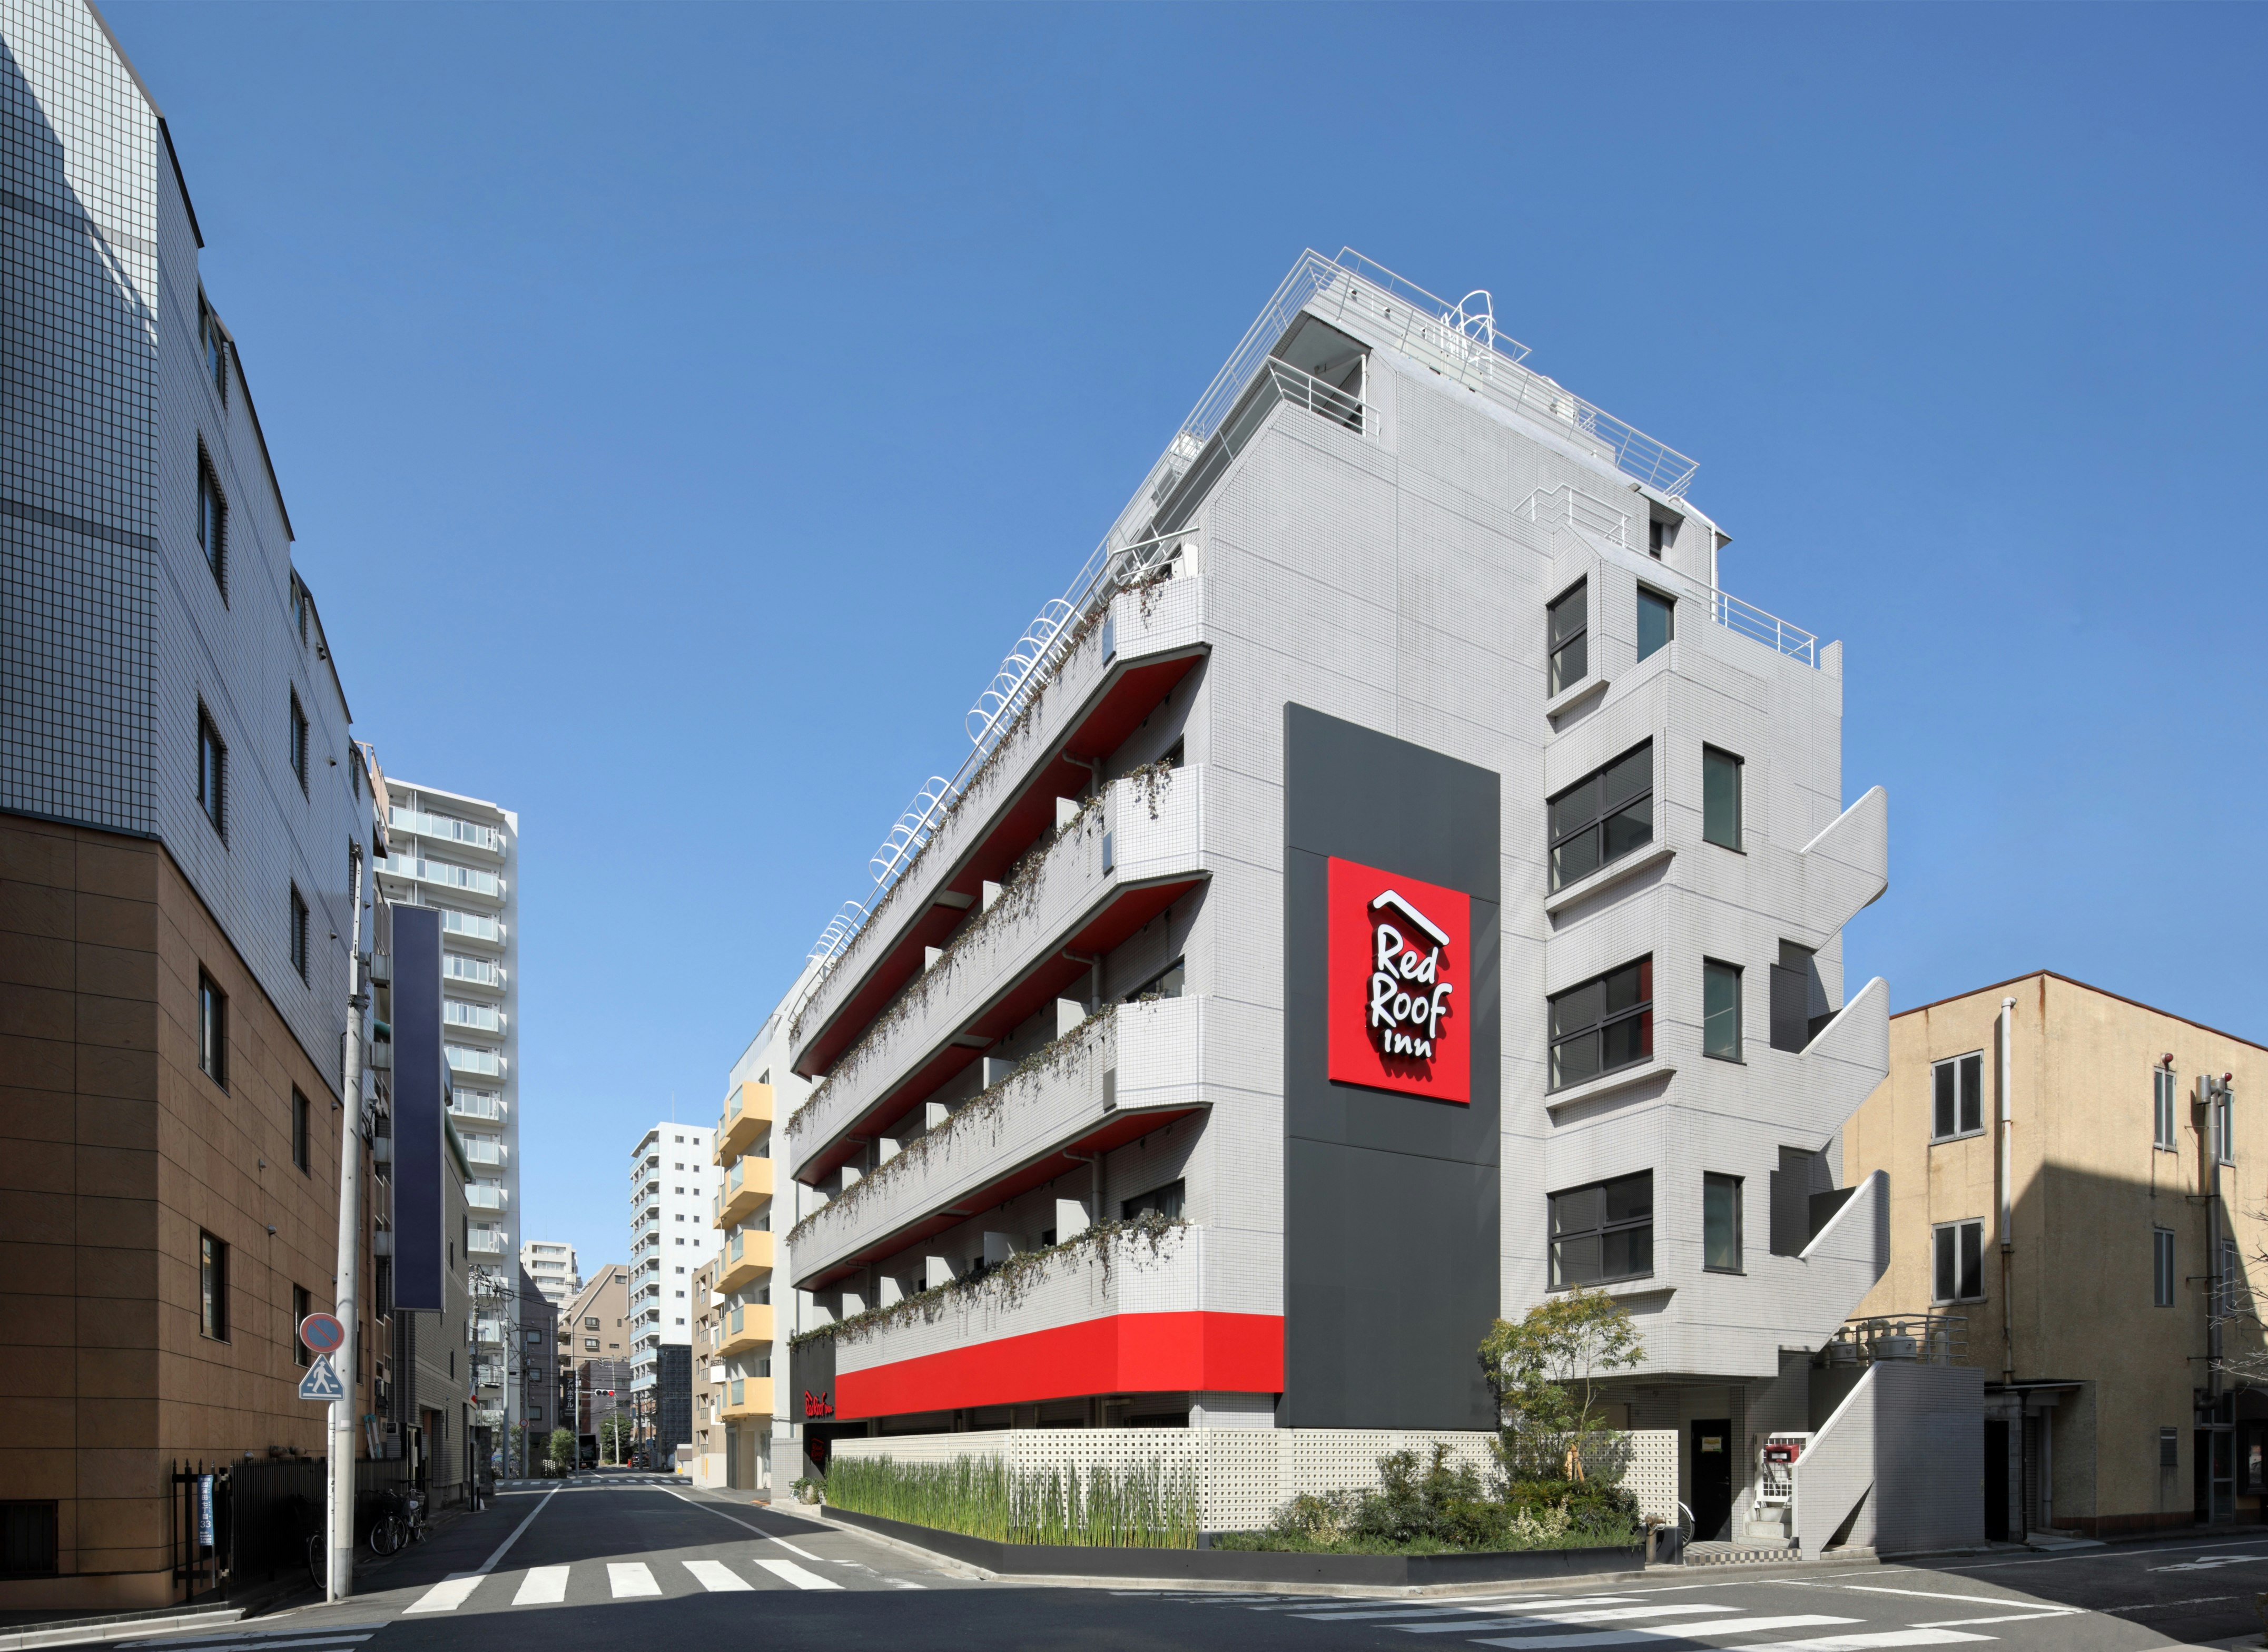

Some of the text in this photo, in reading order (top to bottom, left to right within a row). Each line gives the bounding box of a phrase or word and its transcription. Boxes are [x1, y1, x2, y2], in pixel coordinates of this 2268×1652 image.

[1377, 923, 1438, 984] Red
[1371, 971, 1453, 1039] Roof
[1384, 1028, 1432, 1058] inn
